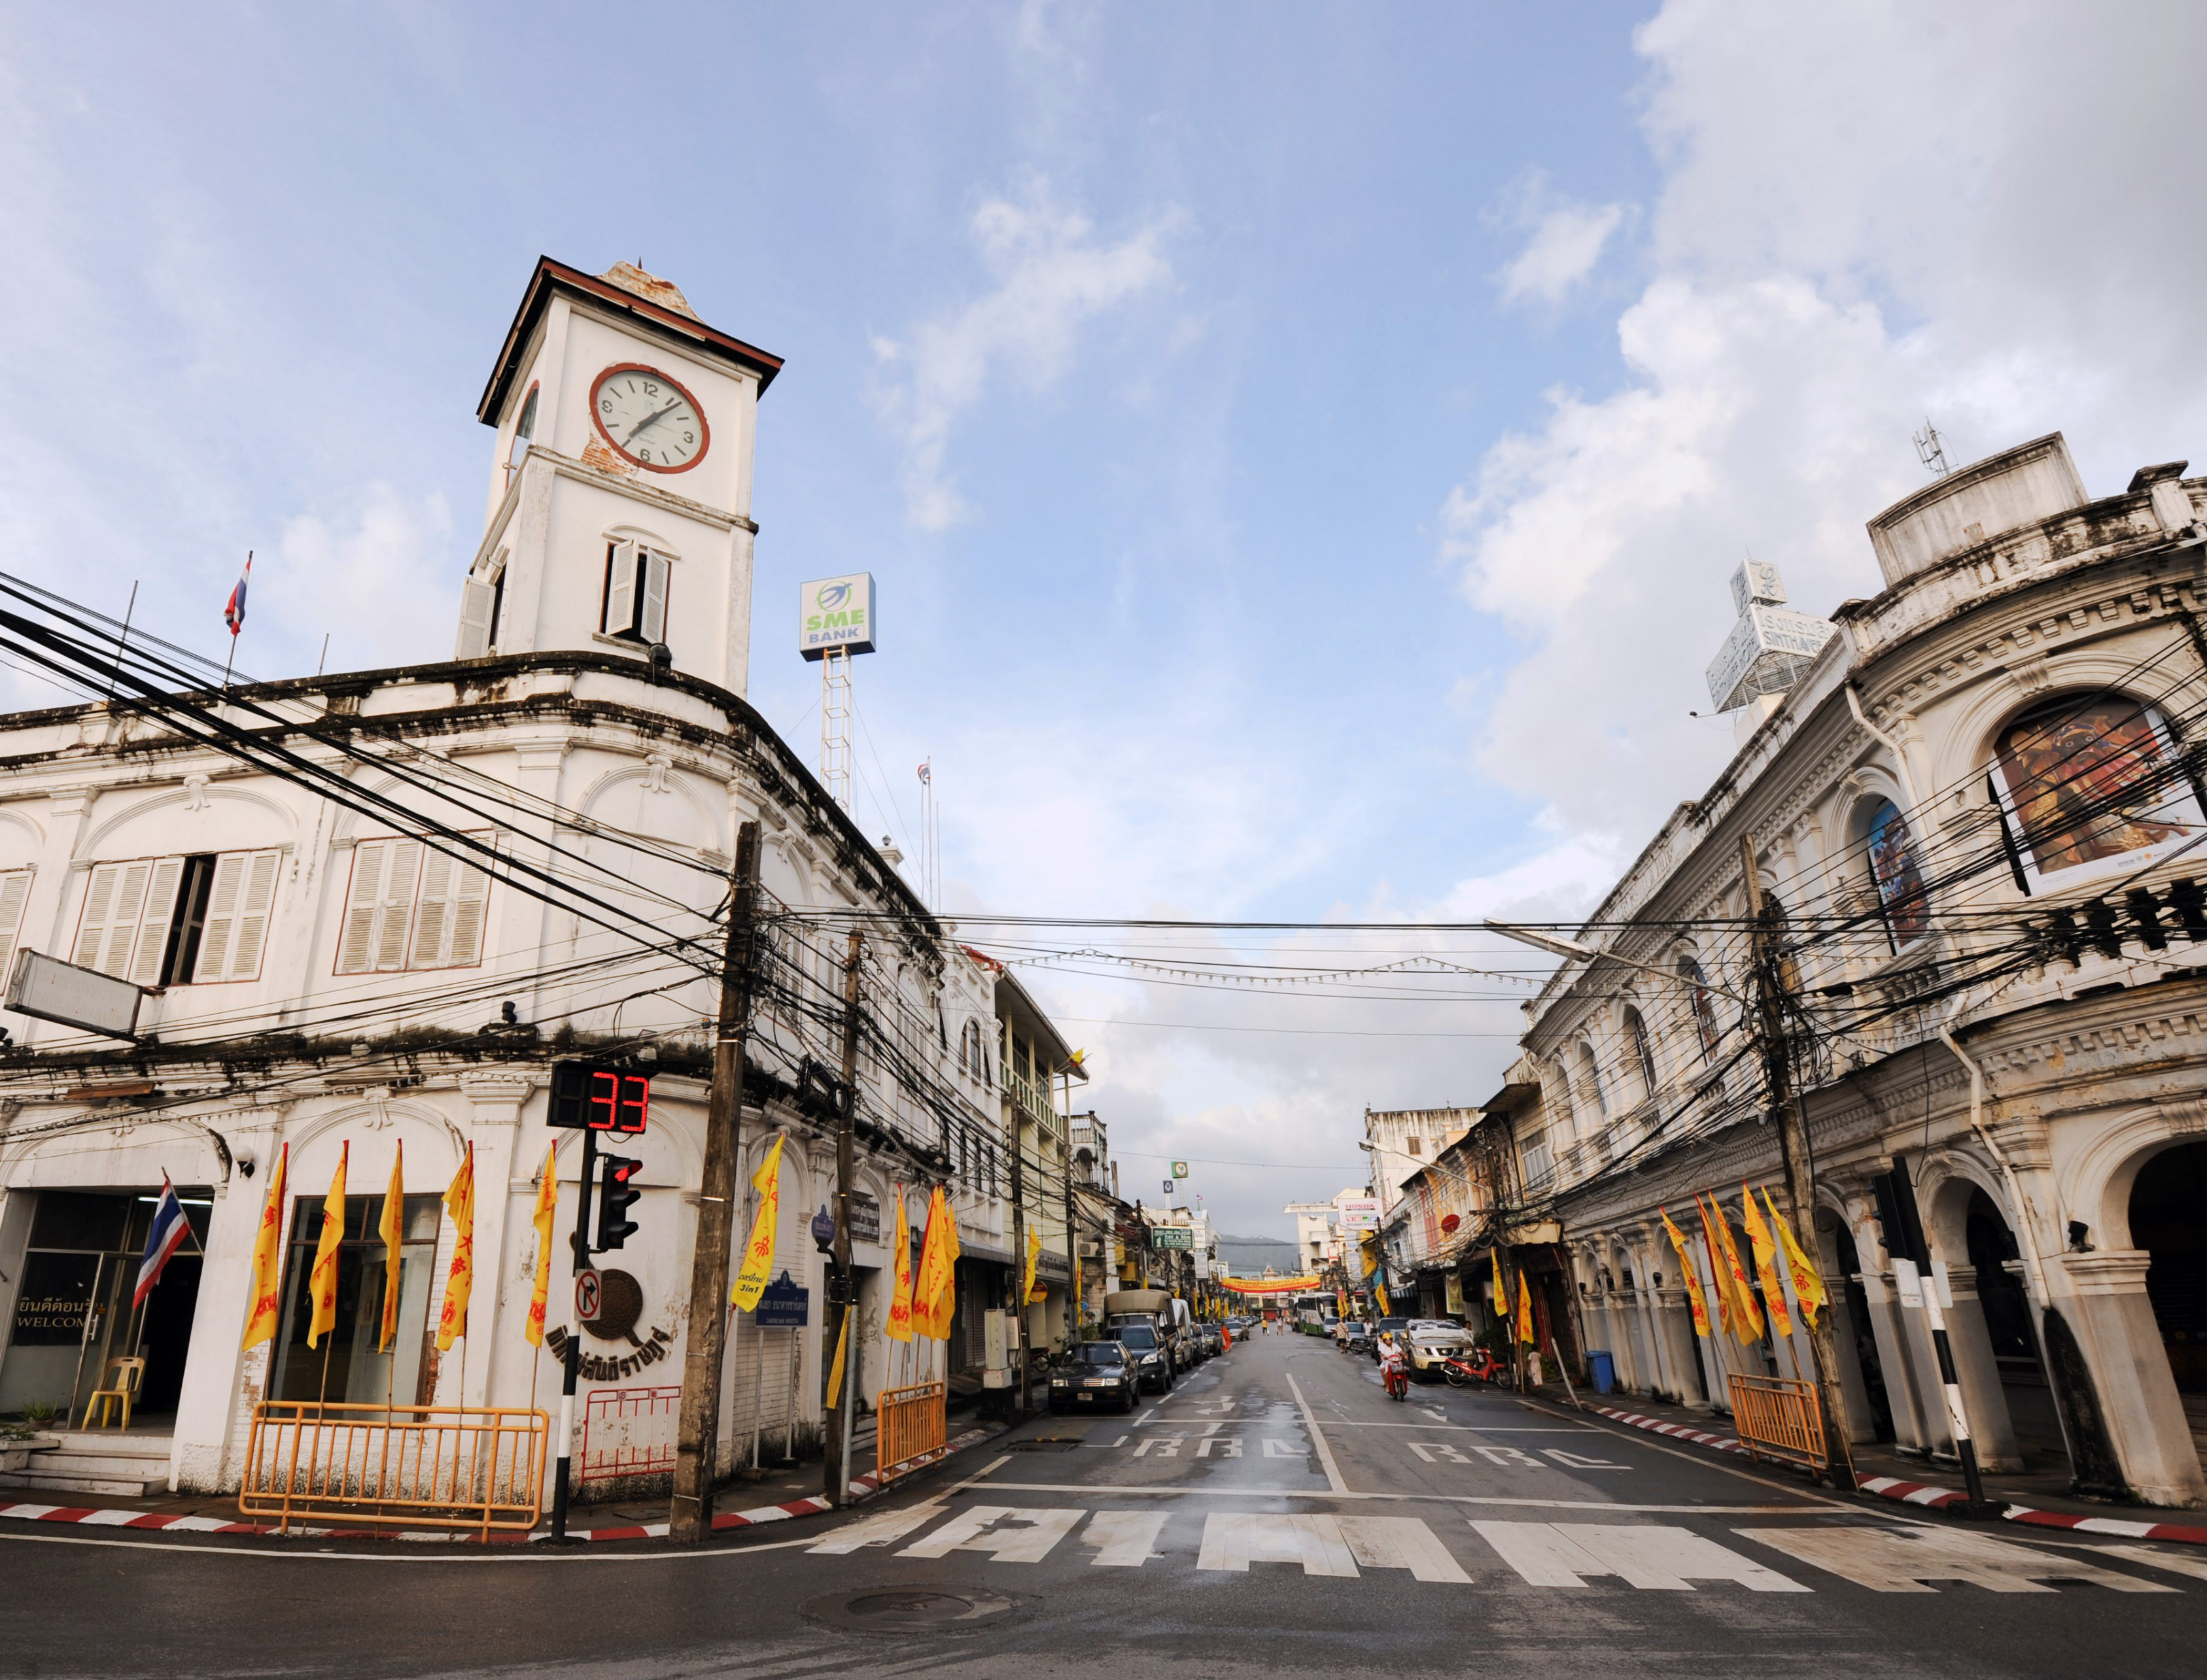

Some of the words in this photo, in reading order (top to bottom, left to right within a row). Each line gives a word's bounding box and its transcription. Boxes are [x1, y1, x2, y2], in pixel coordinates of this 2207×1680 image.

[642, 381, 658, 398] 12
[601, 400, 613, 413] 9
[683, 431, 694, 444] 3
[640, 449, 651, 462] 6
[807, 608, 864, 631] SME
[809, 628, 860, 643] BANK
[589, 1072, 650, 1132] 33
